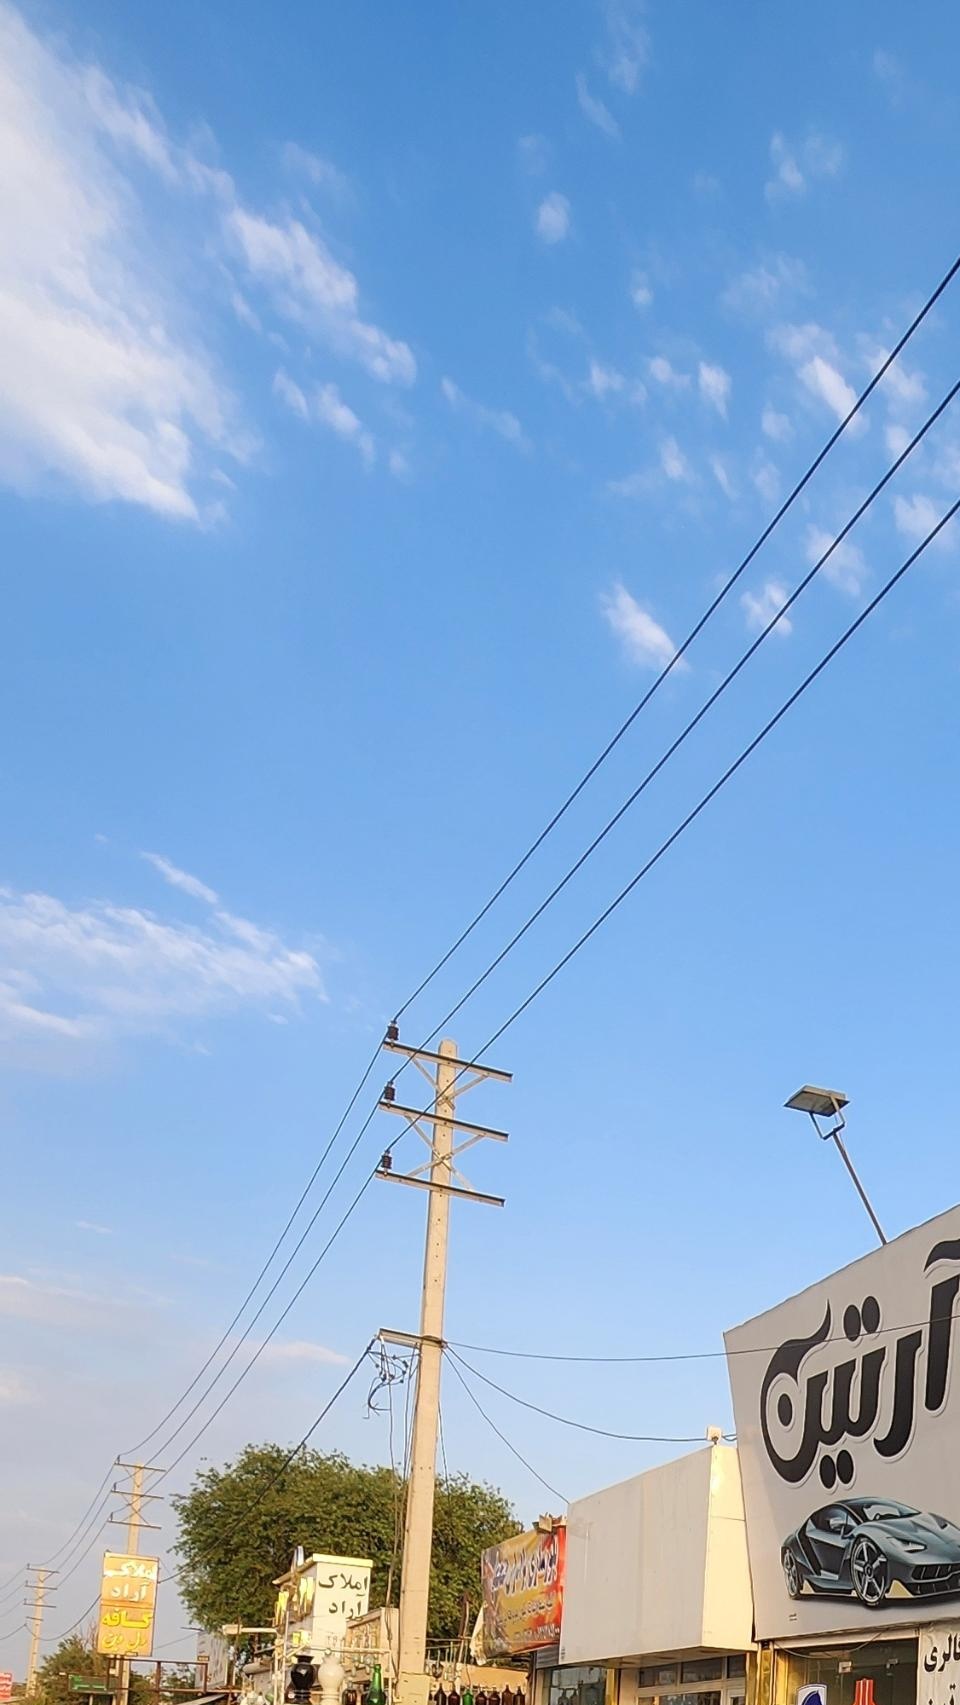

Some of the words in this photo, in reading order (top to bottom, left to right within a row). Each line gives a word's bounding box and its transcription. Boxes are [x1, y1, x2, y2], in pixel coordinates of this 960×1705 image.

[104, 1560, 158, 1581] املاک
[111, 1582, 150, 1602] آراد
[318, 1573, 369, 1592] املاک
[328, 1593, 365, 1621] آراد
[101, 1608, 154, 1629] کافه
